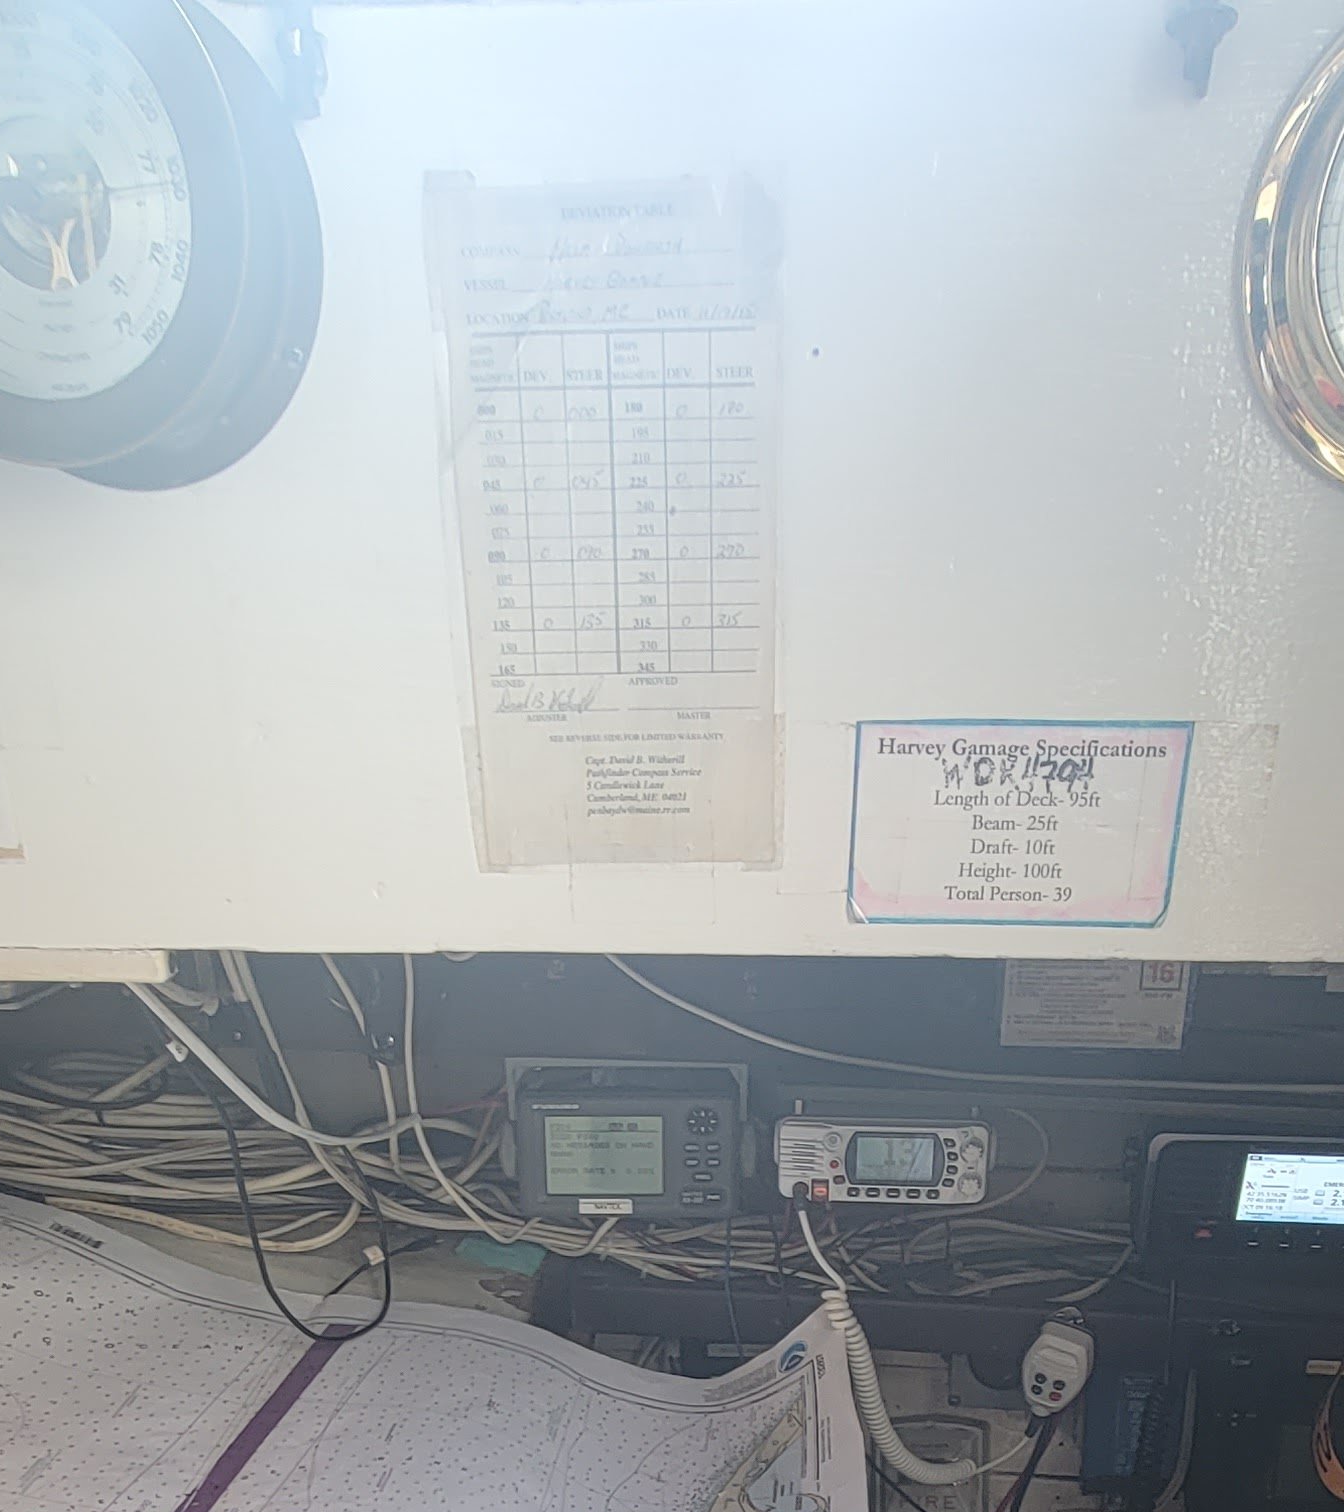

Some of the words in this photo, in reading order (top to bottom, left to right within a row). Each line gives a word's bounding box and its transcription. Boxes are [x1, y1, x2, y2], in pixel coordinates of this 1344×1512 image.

[715, 365, 755, 379] STEER
[624, 402, 644, 414] 180
[877, 737, 947, 762] Harvey
[951, 738, 1030, 763] Gamage
[1035, 738, 1168, 761] Specifications
[933, 789, 990, 810] Length
[993, 788, 1014, 806] of
[1016, 790, 1065, 808] Deck-
[1069, 791, 1102, 808] 95ft
[972, 814, 1022, 831] Beam-
[1026, 815, 1059, 832] 25ft
[969, 838, 1020, 855] Draft-
[1025, 839, 1057, 856] 10ft
[958, 862, 1017, 882] Height-
[1023, 864, 1064, 880] 100ft
[943, 885, 986, 901] Total
[989, 886, 1049, 903] Person-
[1052, 887, 1073, 902] 39
[1147, 961, 1176, 984] 16
